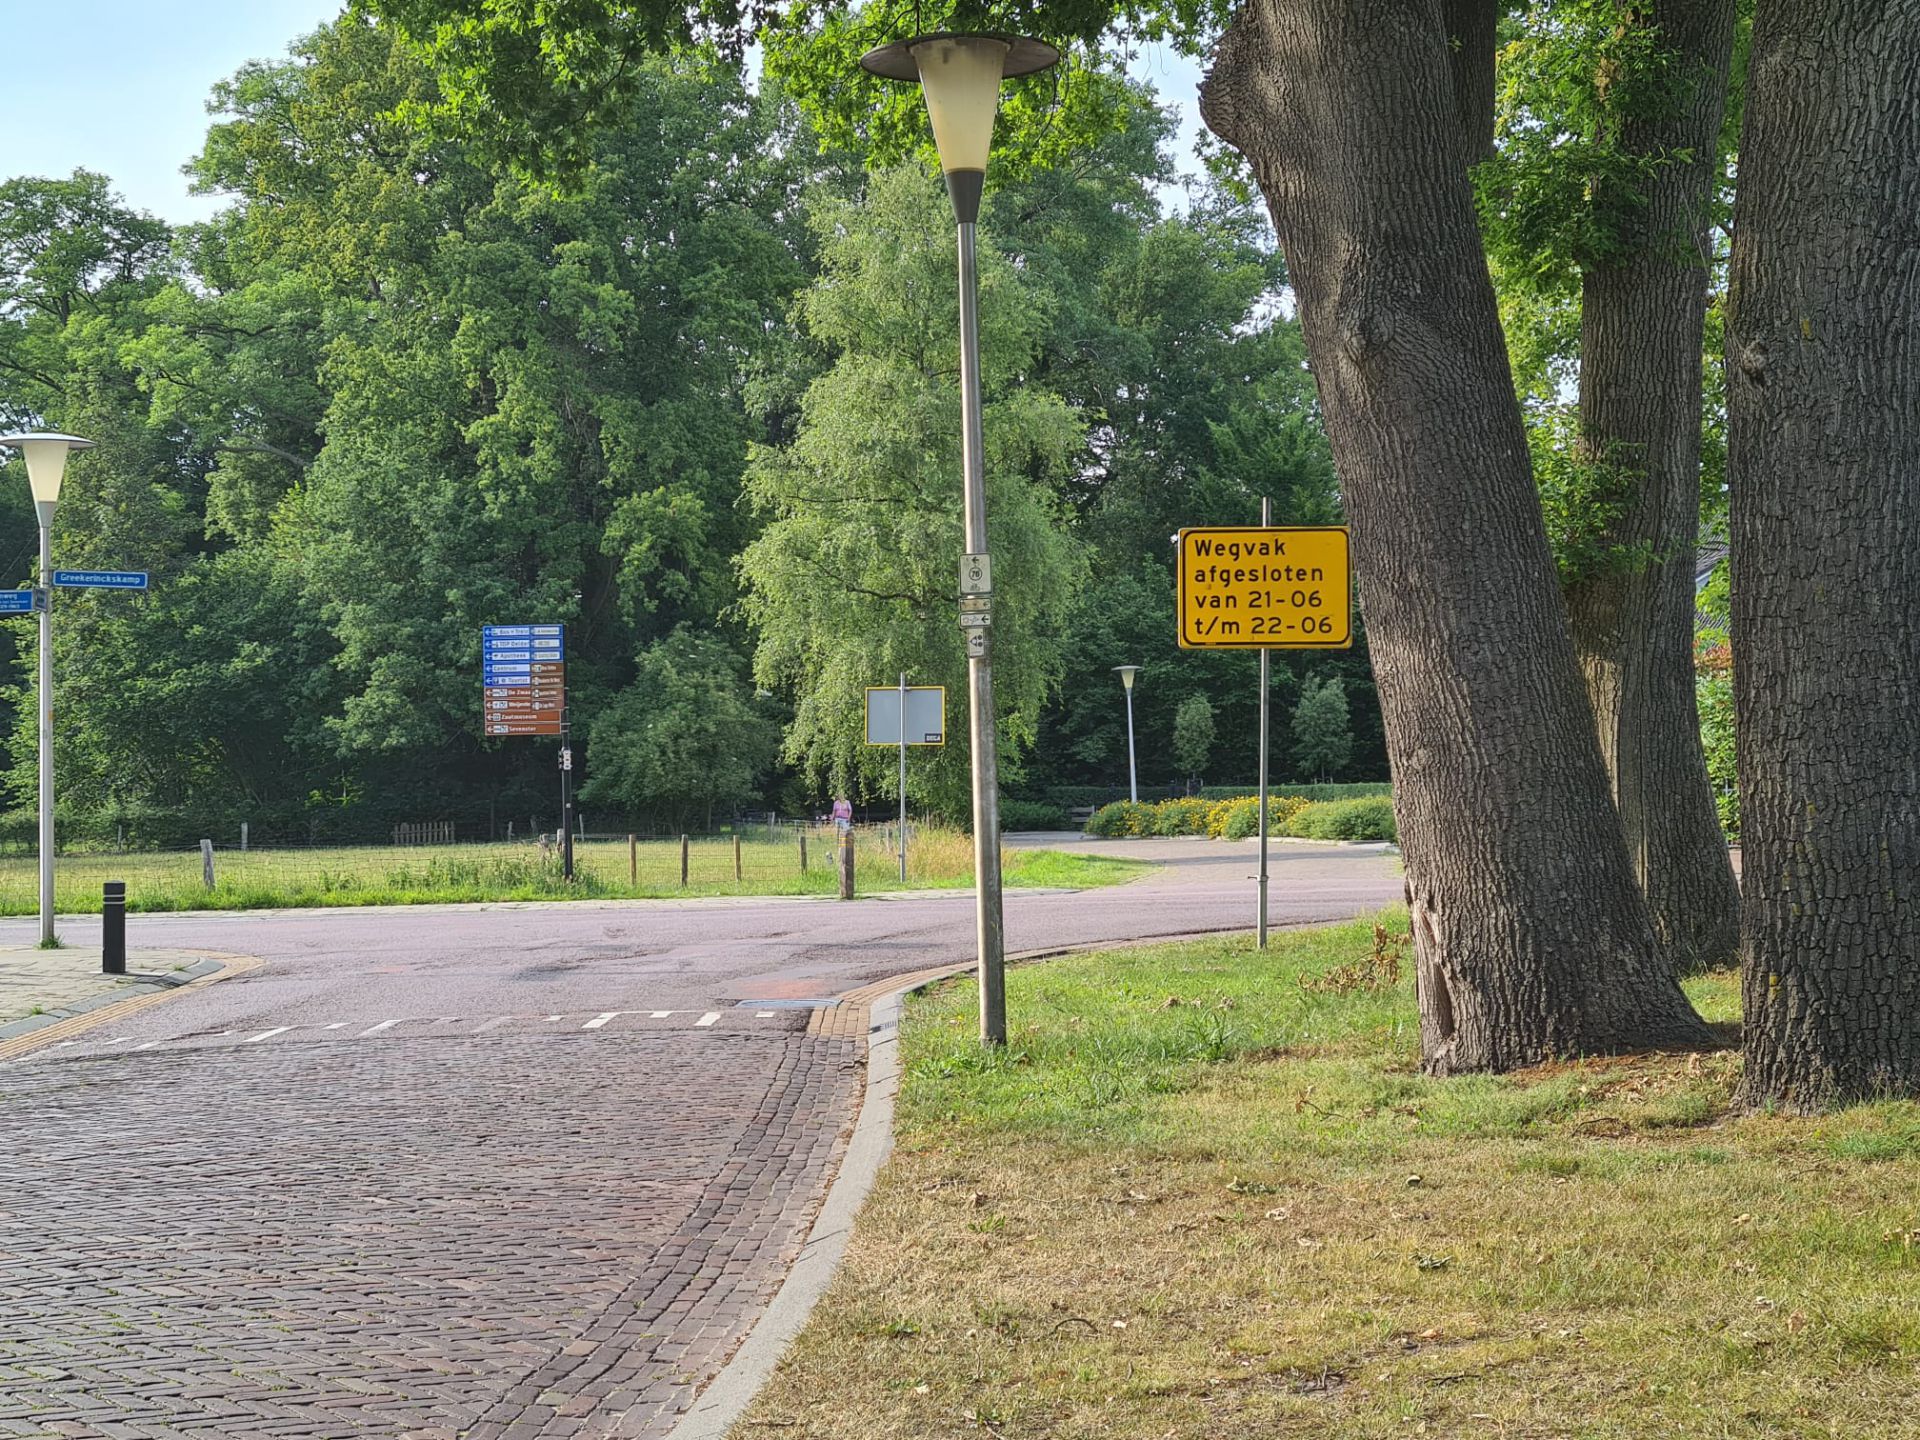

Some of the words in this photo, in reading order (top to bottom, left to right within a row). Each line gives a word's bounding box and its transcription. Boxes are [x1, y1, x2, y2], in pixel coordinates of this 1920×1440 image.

[1194, 539, 1286, 561] Wegvak
[1194, 564, 1323, 588] afgesloten
[1194, 595, 1238, 608] van
[1248, 590, 1323, 608] 21-06
[1194, 615, 1240, 635] t/m
[1251, 616, 1333, 634] 22-06
